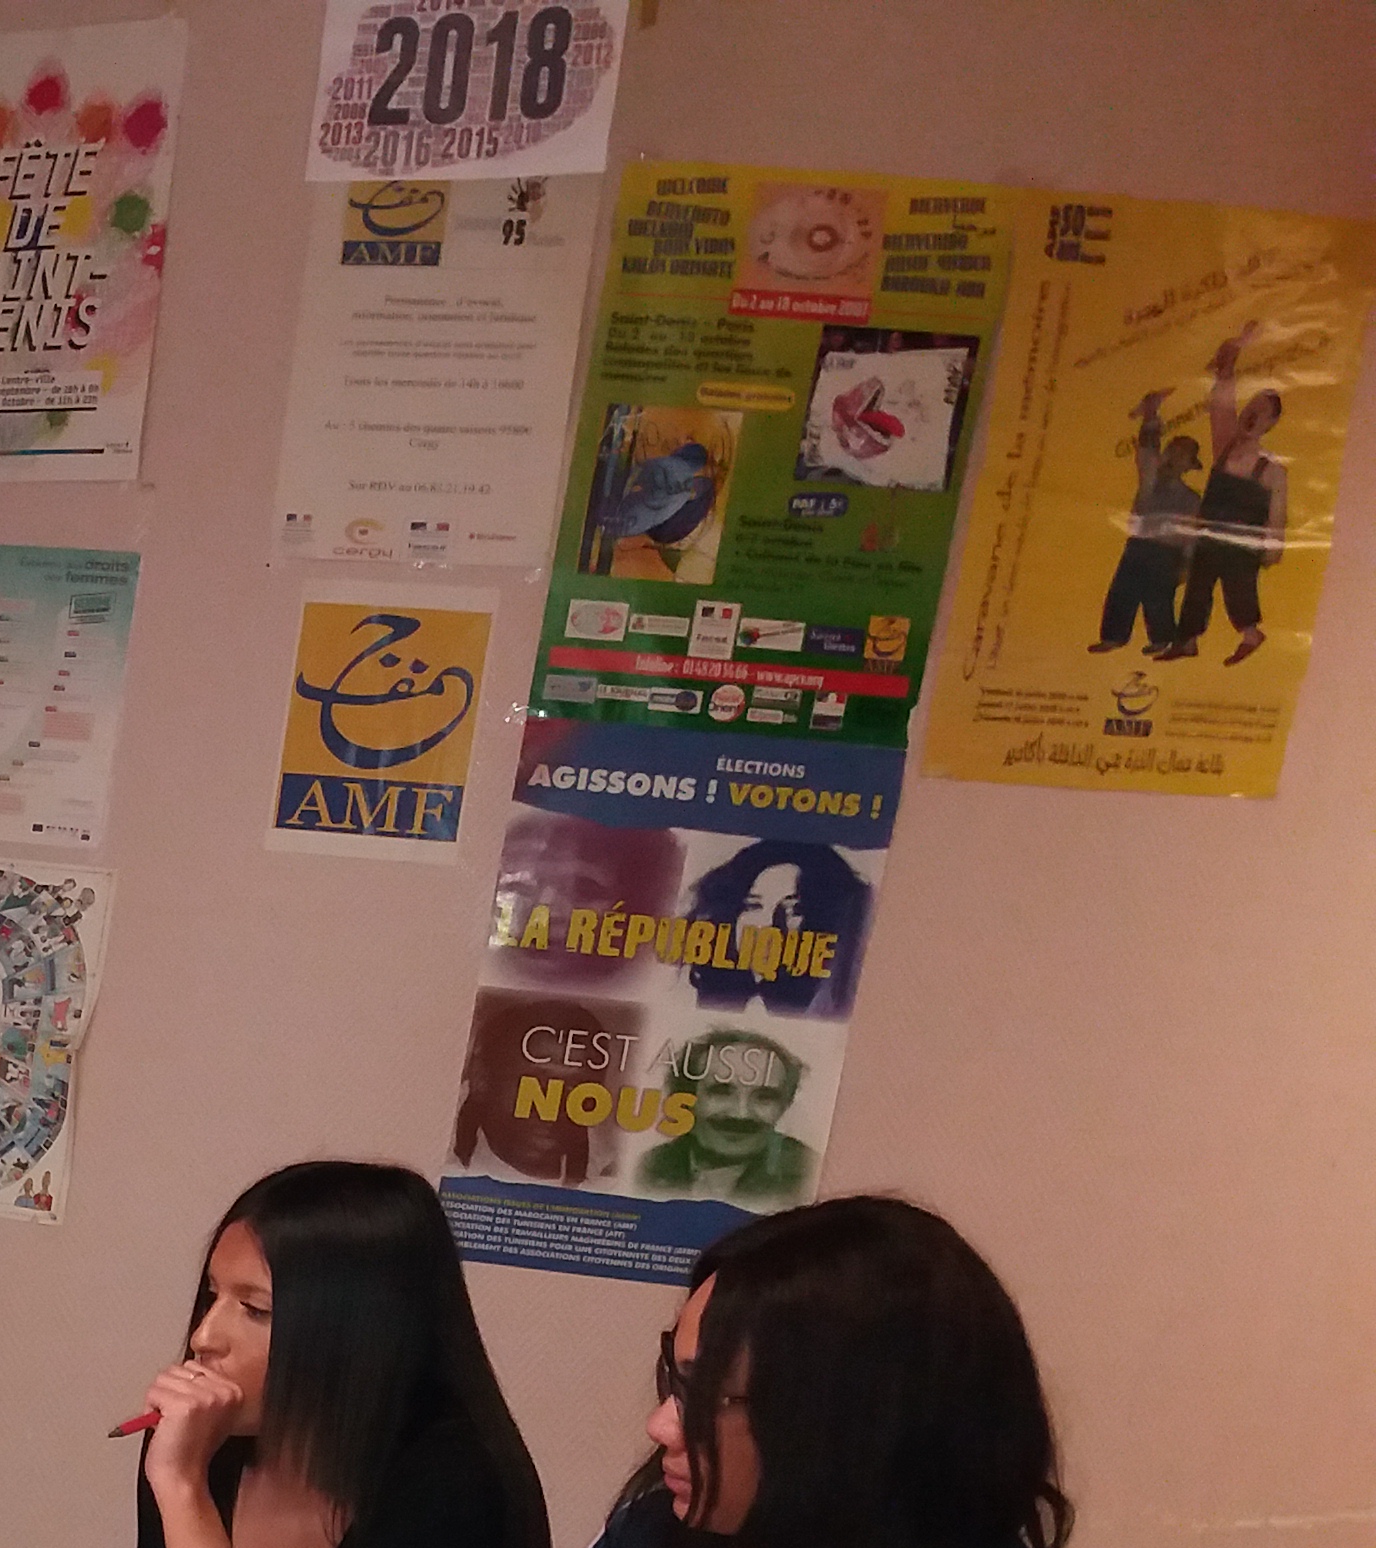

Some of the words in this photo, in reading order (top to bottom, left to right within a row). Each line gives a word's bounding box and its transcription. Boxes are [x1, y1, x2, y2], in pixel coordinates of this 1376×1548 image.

[367, 5, 573, 126] 2018
[318, 121, 364, 147] 2013
[364, 129, 432, 166] 2016
[441, 126, 500, 160] 2015
[3, 203, 67, 252] DE
[348, 242, 439, 265] AMF
[528, 763, 696, 802] AGISSONS
[706, 778, 717, 803] !
[728, 783, 860, 818] VOTONS
[870, 795, 883, 820] !
[715, 754, 805, 779] ÉLECTIONS
[284, 779, 454, 835] AMF
[488, 900, 552, 950] LA
[566, 901, 839, 983] RÉPUBLIQUE
[521, 1024, 640, 1073] C'EST
[648, 1034, 780, 1089] AUSSI
[514, 1075, 697, 1137] NOUS
